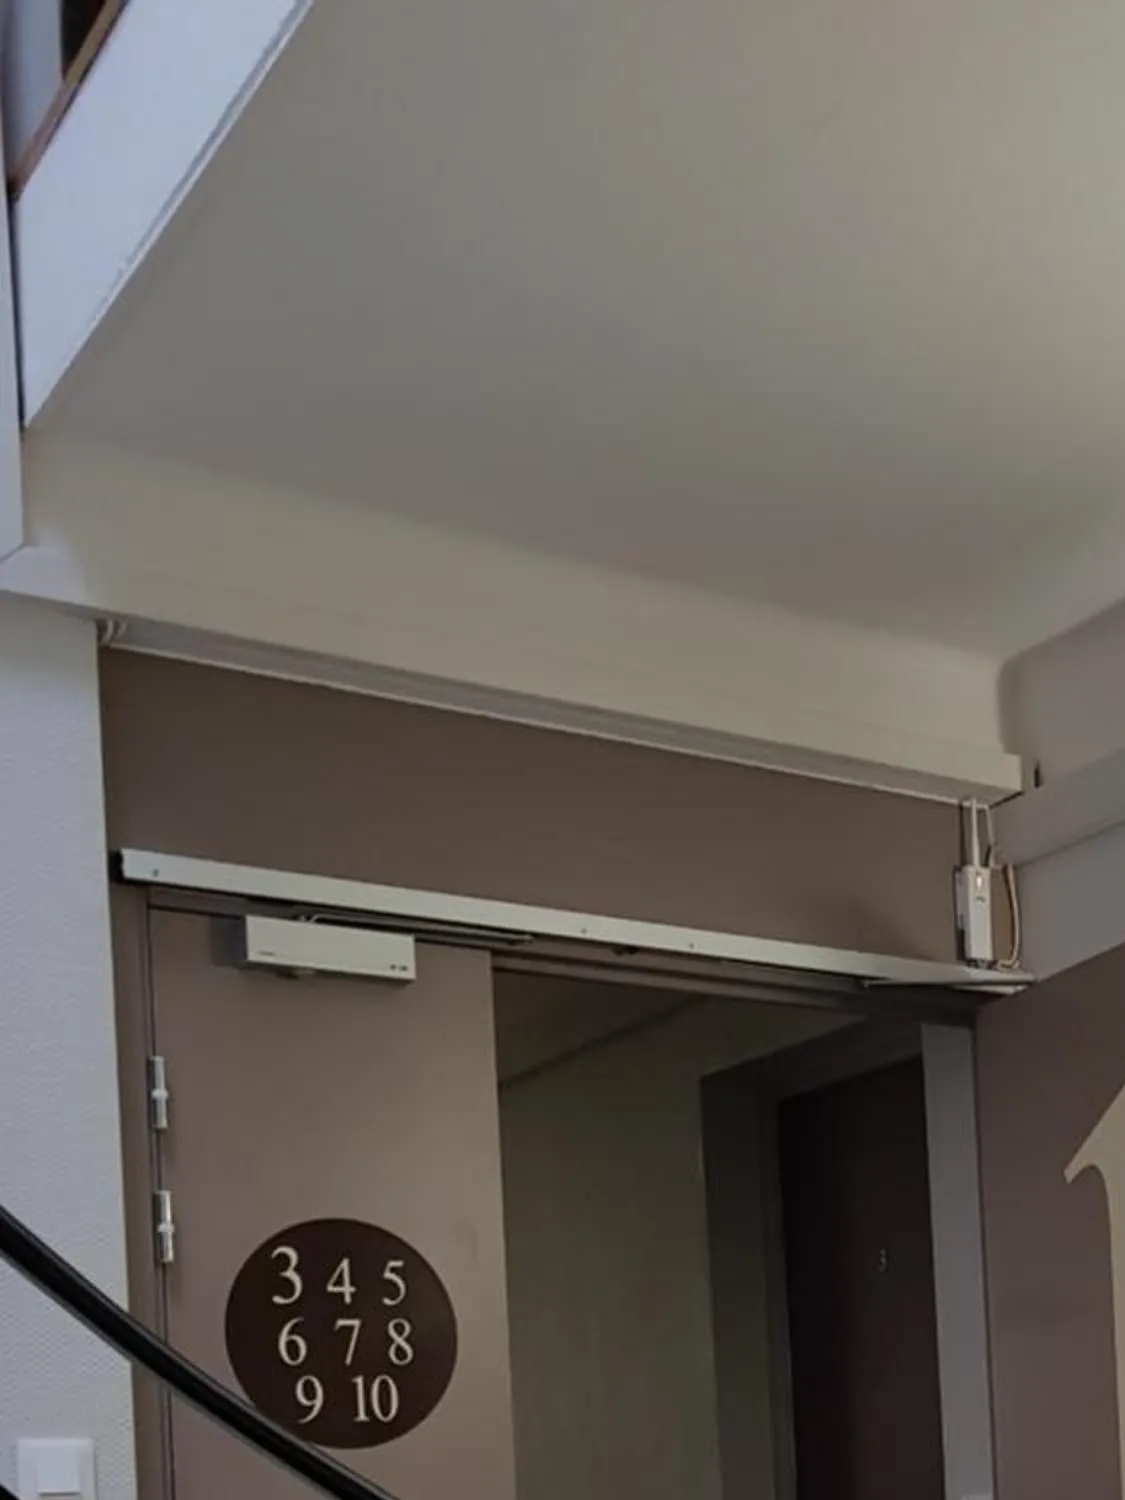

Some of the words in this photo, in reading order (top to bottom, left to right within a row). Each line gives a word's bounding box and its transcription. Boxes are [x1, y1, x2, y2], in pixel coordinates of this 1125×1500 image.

[271, 1245, 303, 1304] 3
[326, 1258, 356, 1304] 4
[382, 1260, 406, 1306] 5
[277, 1317, 307, 1366] 6
[334, 1319, 362, 1366] 7
[387, 1318, 414, 1365] 8
[295, 1375, 324, 1424] 9
[352, 1375, 399, 1423] 10
